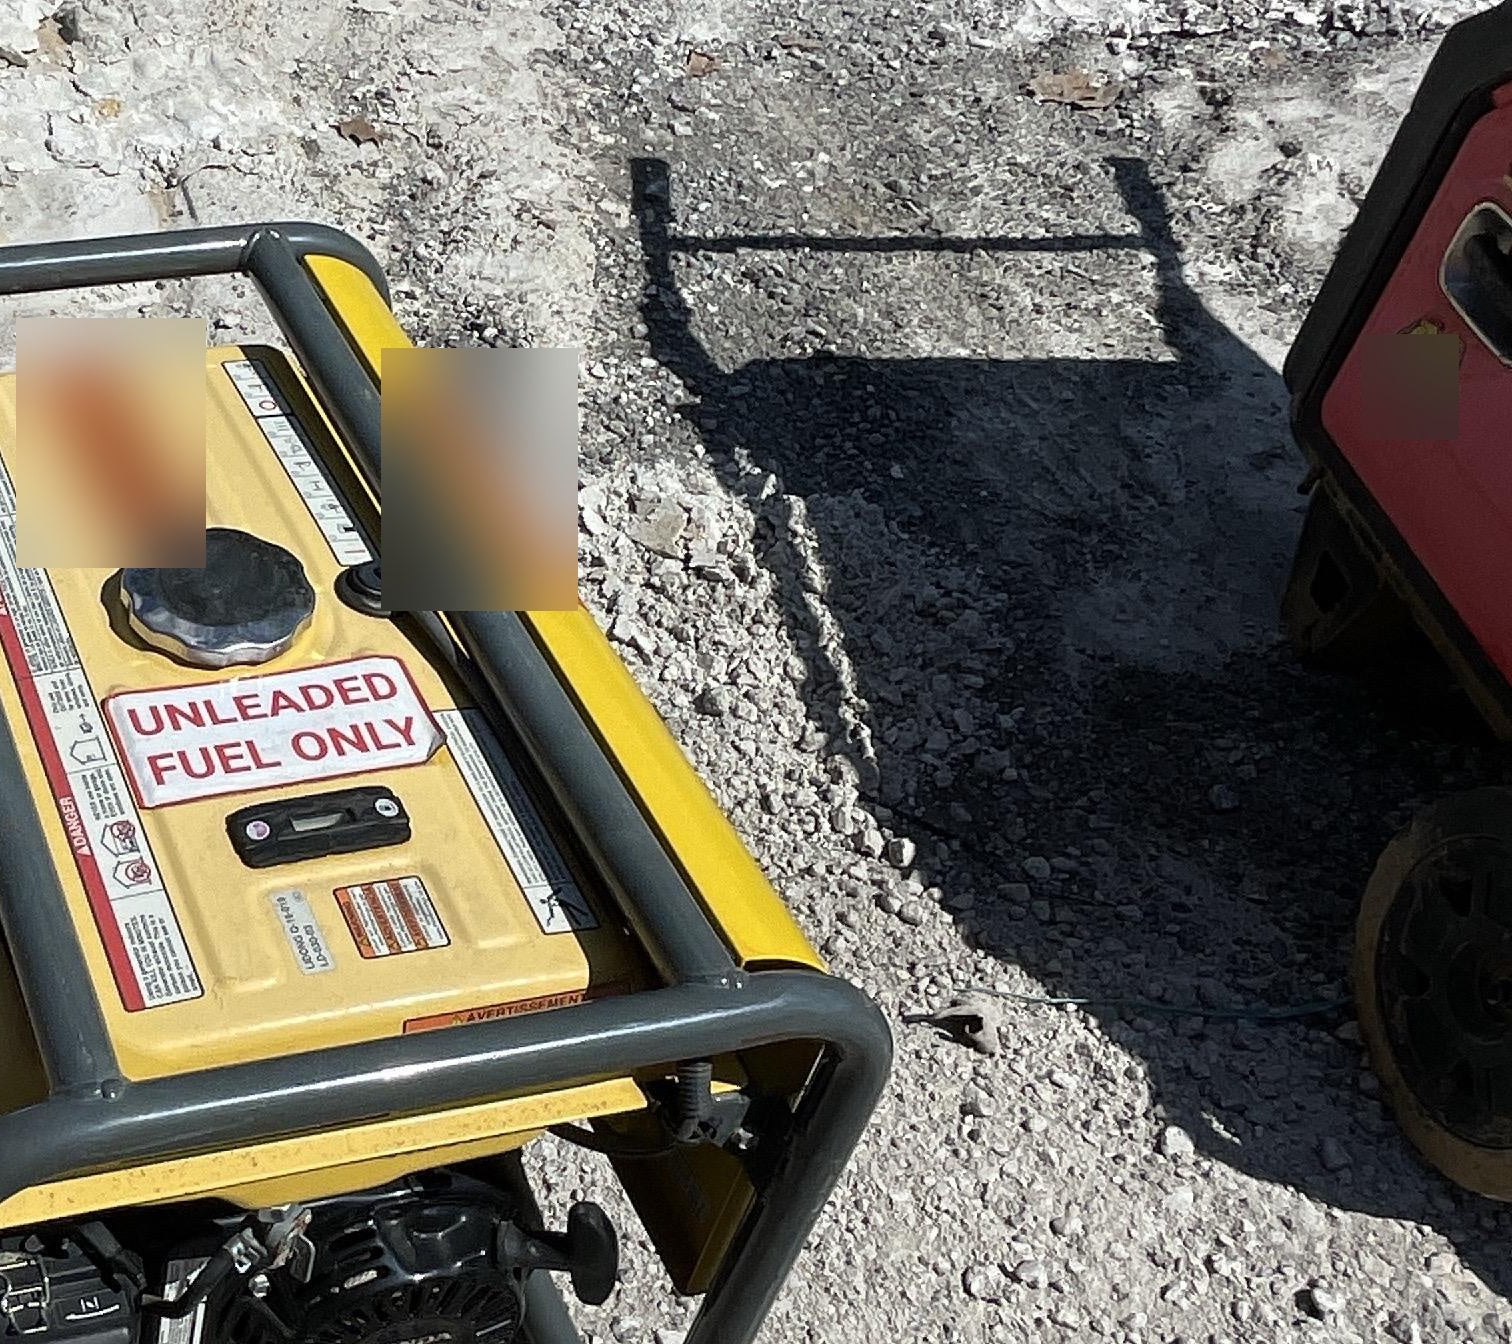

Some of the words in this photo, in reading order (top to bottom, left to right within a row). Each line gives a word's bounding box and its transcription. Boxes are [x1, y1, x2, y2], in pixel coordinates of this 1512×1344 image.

[127, 672, 398, 736] UNLEADED
[146, 739, 282, 786] FUEL
[291, 716, 416, 762] ONLY
[59, 796, 87, 847] DANGER
